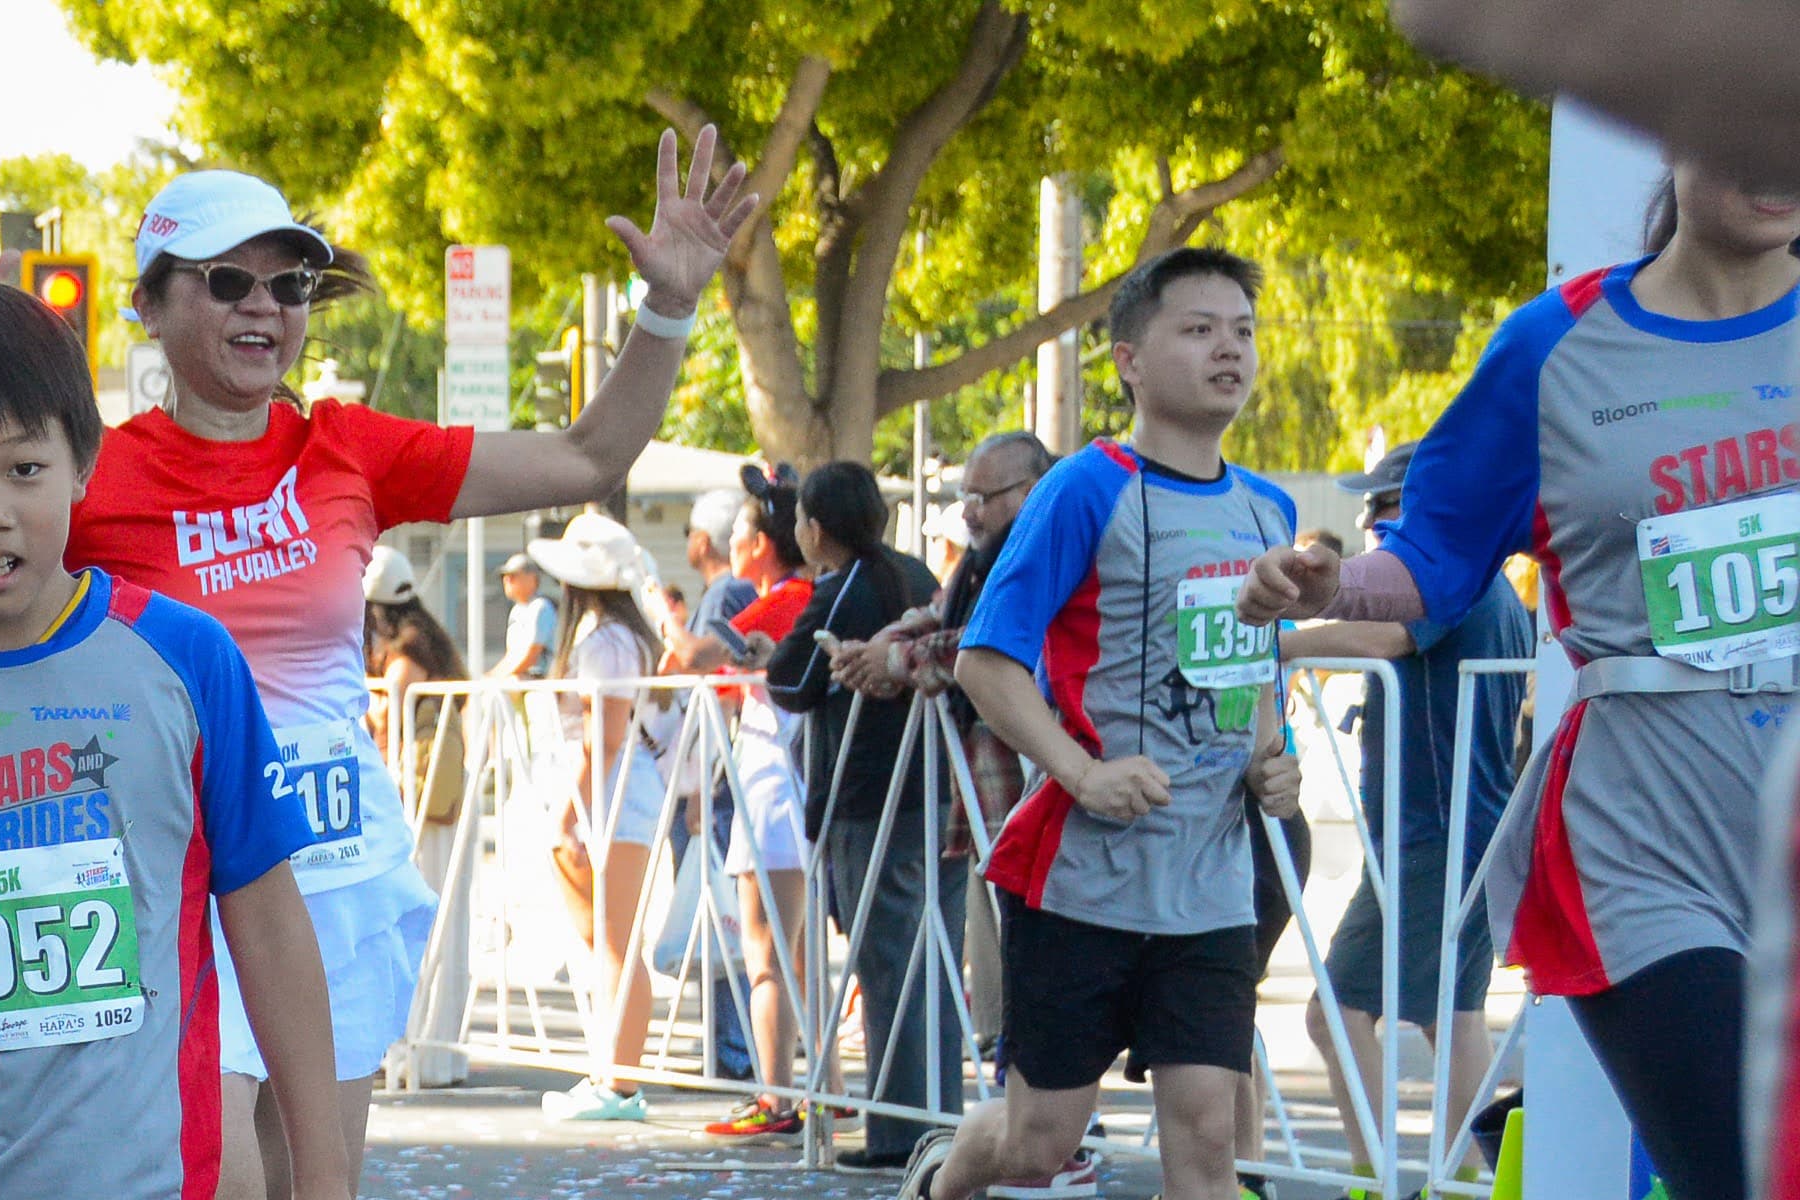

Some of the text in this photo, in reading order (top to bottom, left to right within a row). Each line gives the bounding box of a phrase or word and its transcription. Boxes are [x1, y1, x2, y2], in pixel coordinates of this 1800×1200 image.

[1649, 423, 1800, 515] STARS
[173, 465, 310, 568] BURN
[1738, 513, 1763, 538] 5K
[195, 538, 318, 597] TRI-VALLEY
[1667, 543, 1800, 635] 105
[1684, 648, 1715, 665] RINK
[30, 705, 110, 722] TARANA
[78, 753, 104, 773] AND
[282, 742, 300, 763] 0K
[39, 1017, 85, 1033] HAPA'S
[94, 1007, 133, 1028] 1052
